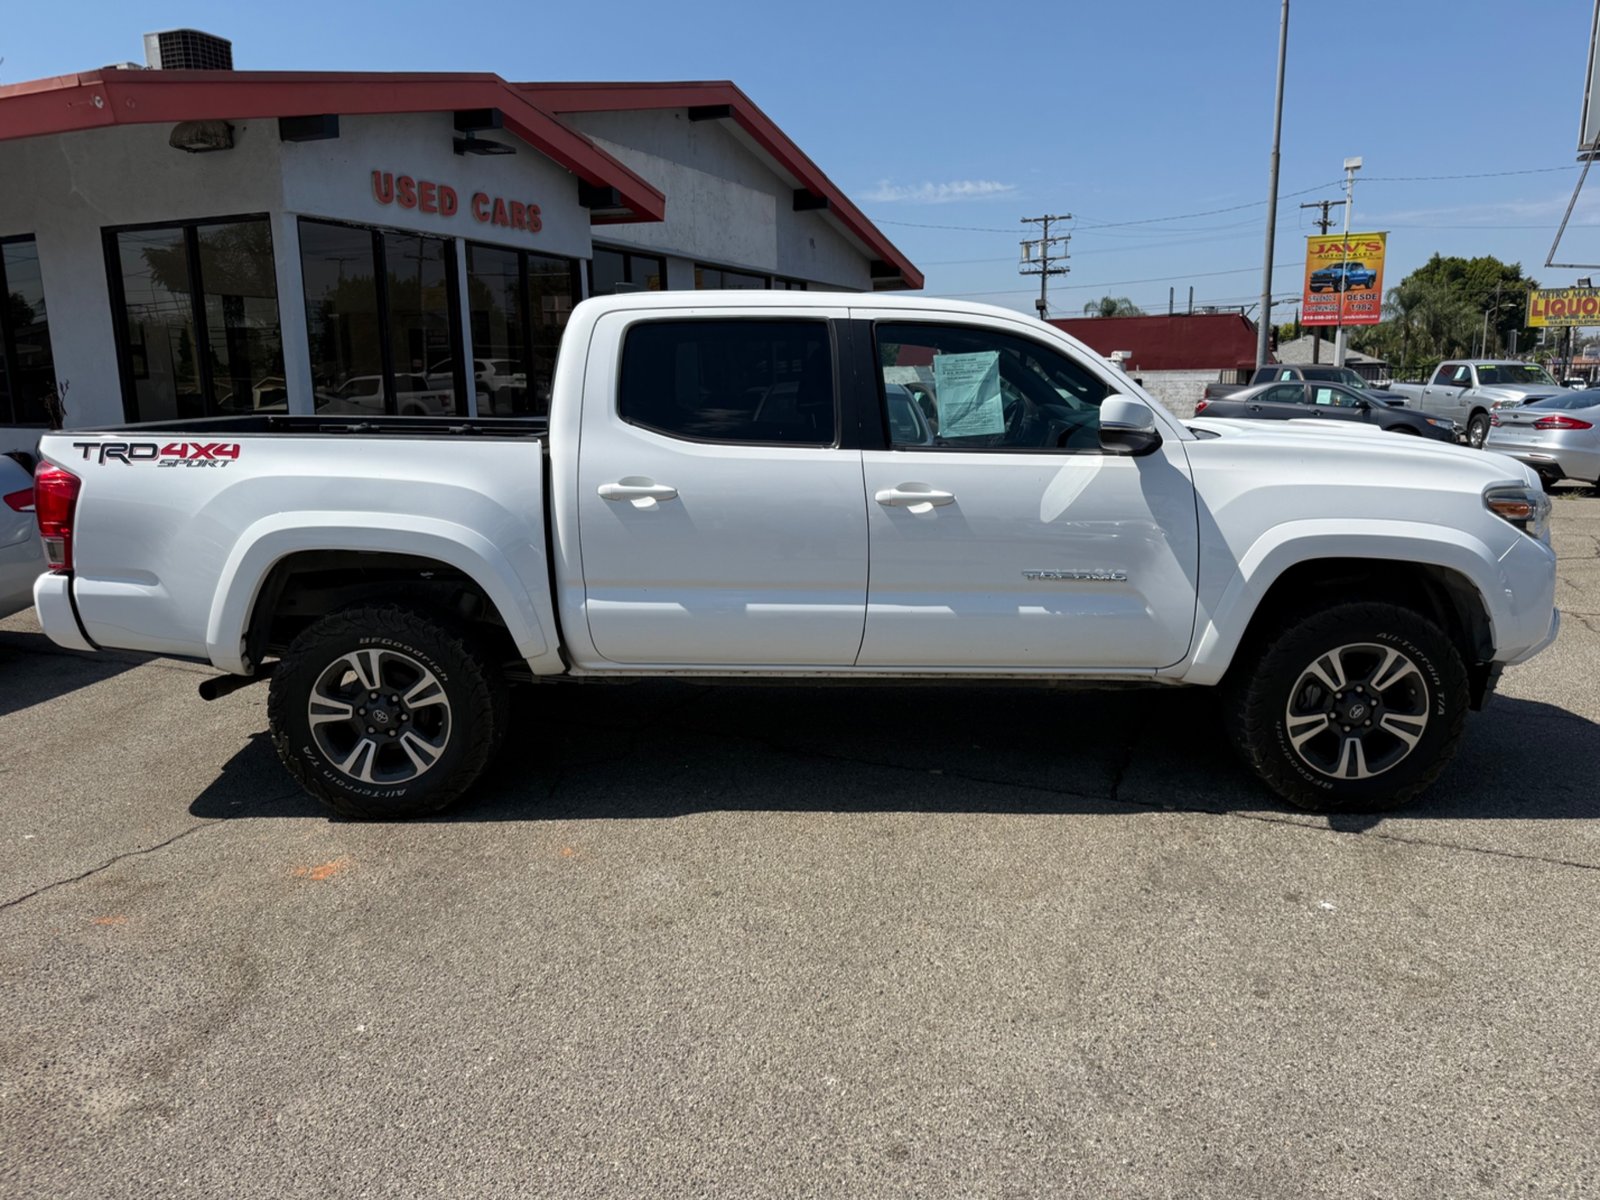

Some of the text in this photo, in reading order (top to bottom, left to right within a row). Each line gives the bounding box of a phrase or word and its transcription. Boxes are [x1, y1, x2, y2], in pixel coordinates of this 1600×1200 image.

[372, 170, 543, 233] USED CARS
[1309, 242, 1382, 254] JAV'S
[1346, 293, 1378, 301] DESDE
[1537, 290, 1569, 299] METRO
[1351, 303, 1373, 311] 1982
[1532, 298, 1600, 317] LIQUO
[73, 442, 159, 466] TRD
[157, 458, 235, 468] SPORT
[359, 637, 449, 682] BFGoodrich
[1376, 632, 1446, 716] All-Terrain T/A
[323, 770, 408, 798] All-Terrain
